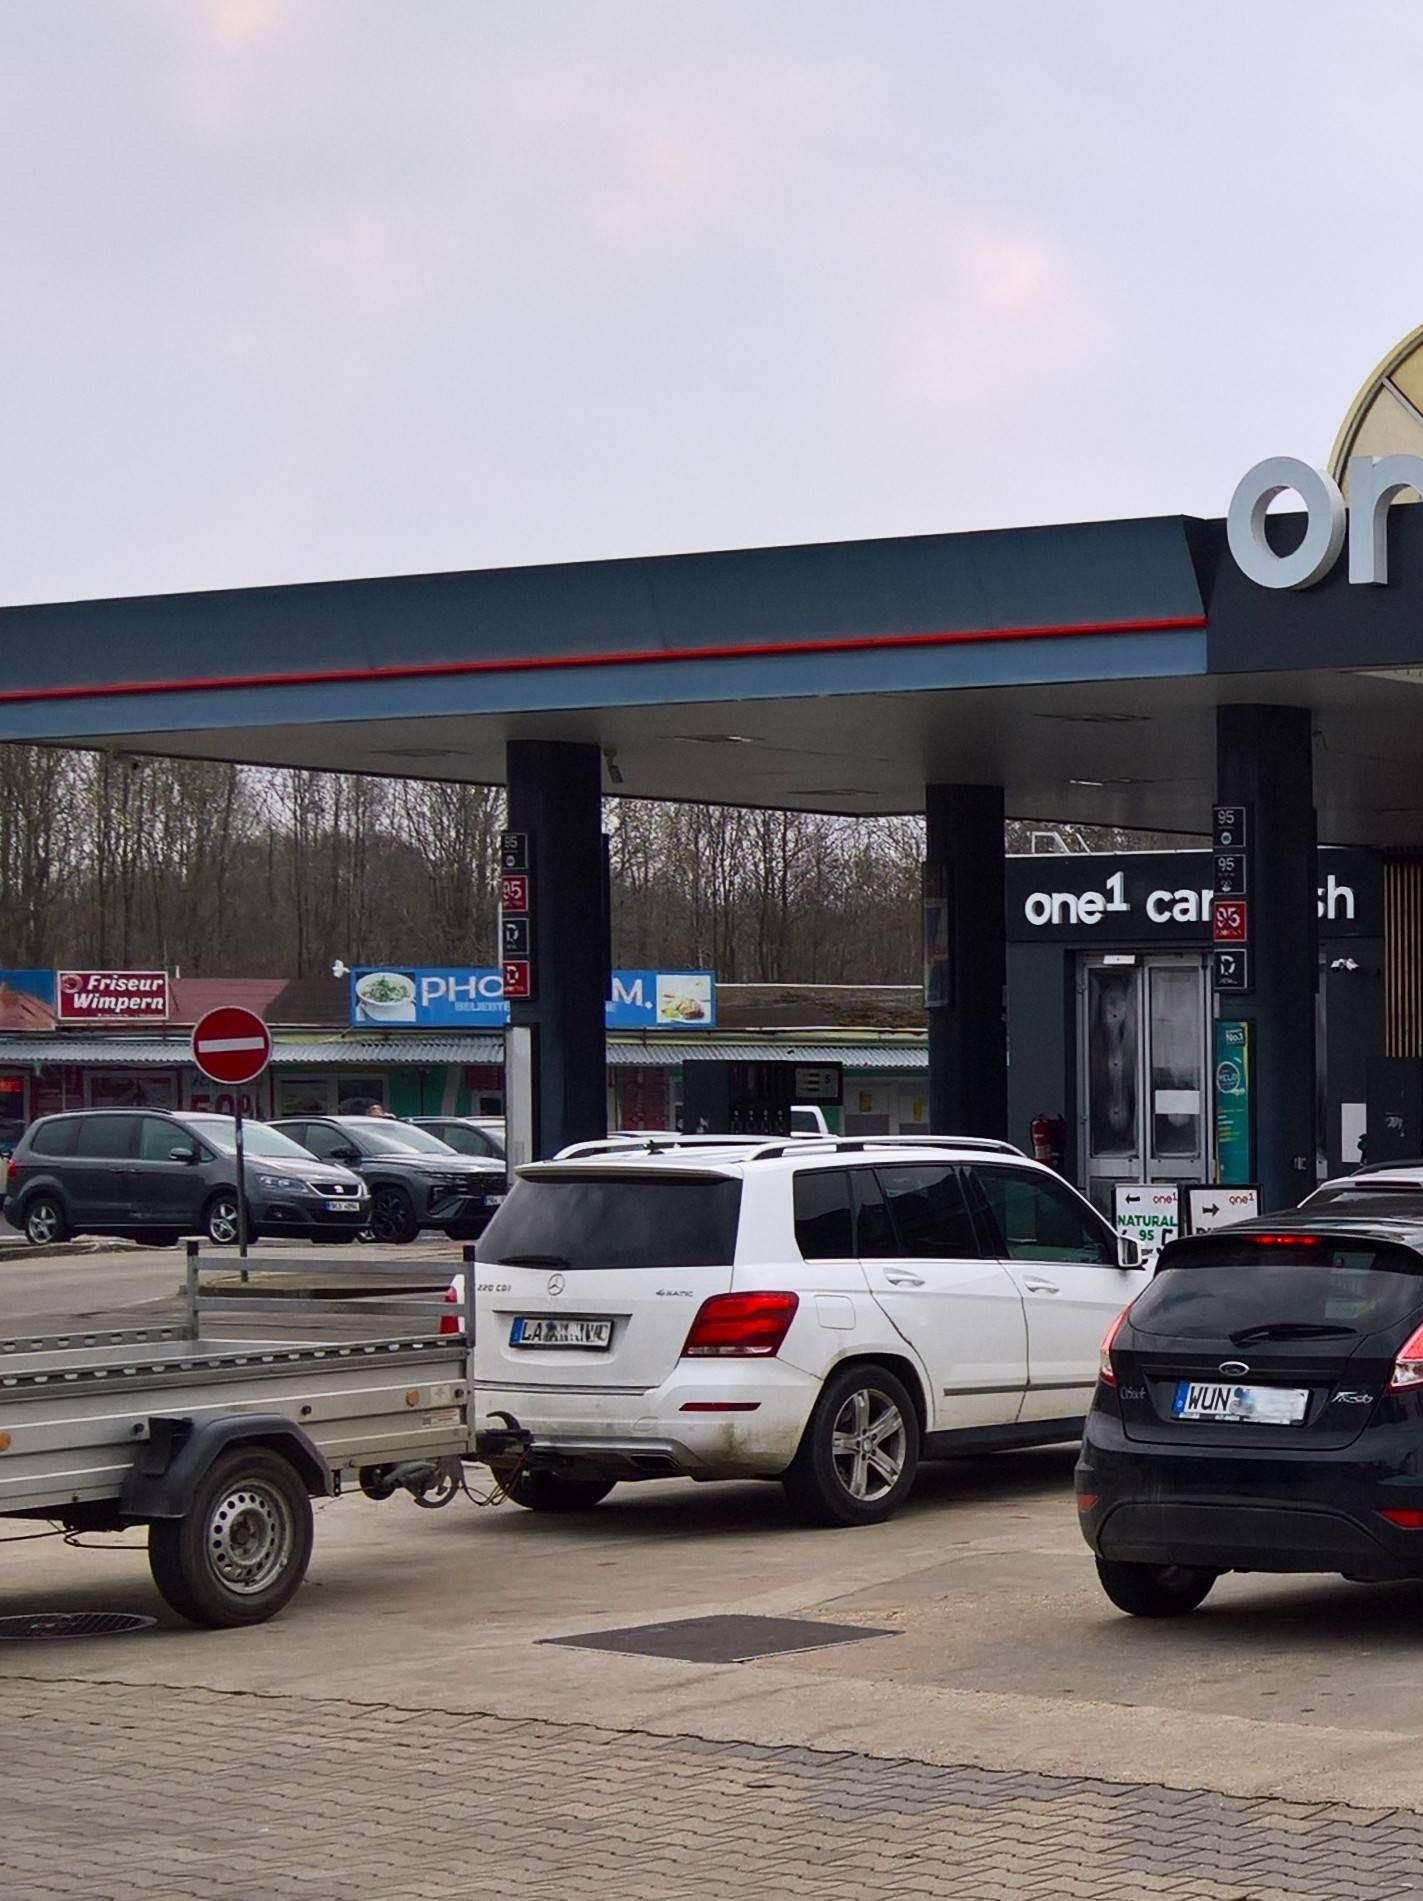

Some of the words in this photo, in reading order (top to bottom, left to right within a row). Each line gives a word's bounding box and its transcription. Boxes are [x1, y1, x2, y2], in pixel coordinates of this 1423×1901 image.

[1217, 810, 1235, 824] 95
[1217, 857, 1235, 871] 95
[503, 881, 522, 899] 95
[87, 974, 164, 991] Friseur
[73, 993, 164, 1013] Wimpern
[1118, 1215, 1178, 1228] NATURAL
[1139, 1229, 1155, 1241] 95
[477, 1284, 493, 1292] 220
[1187, 1385, 1231, 1414] WUN
